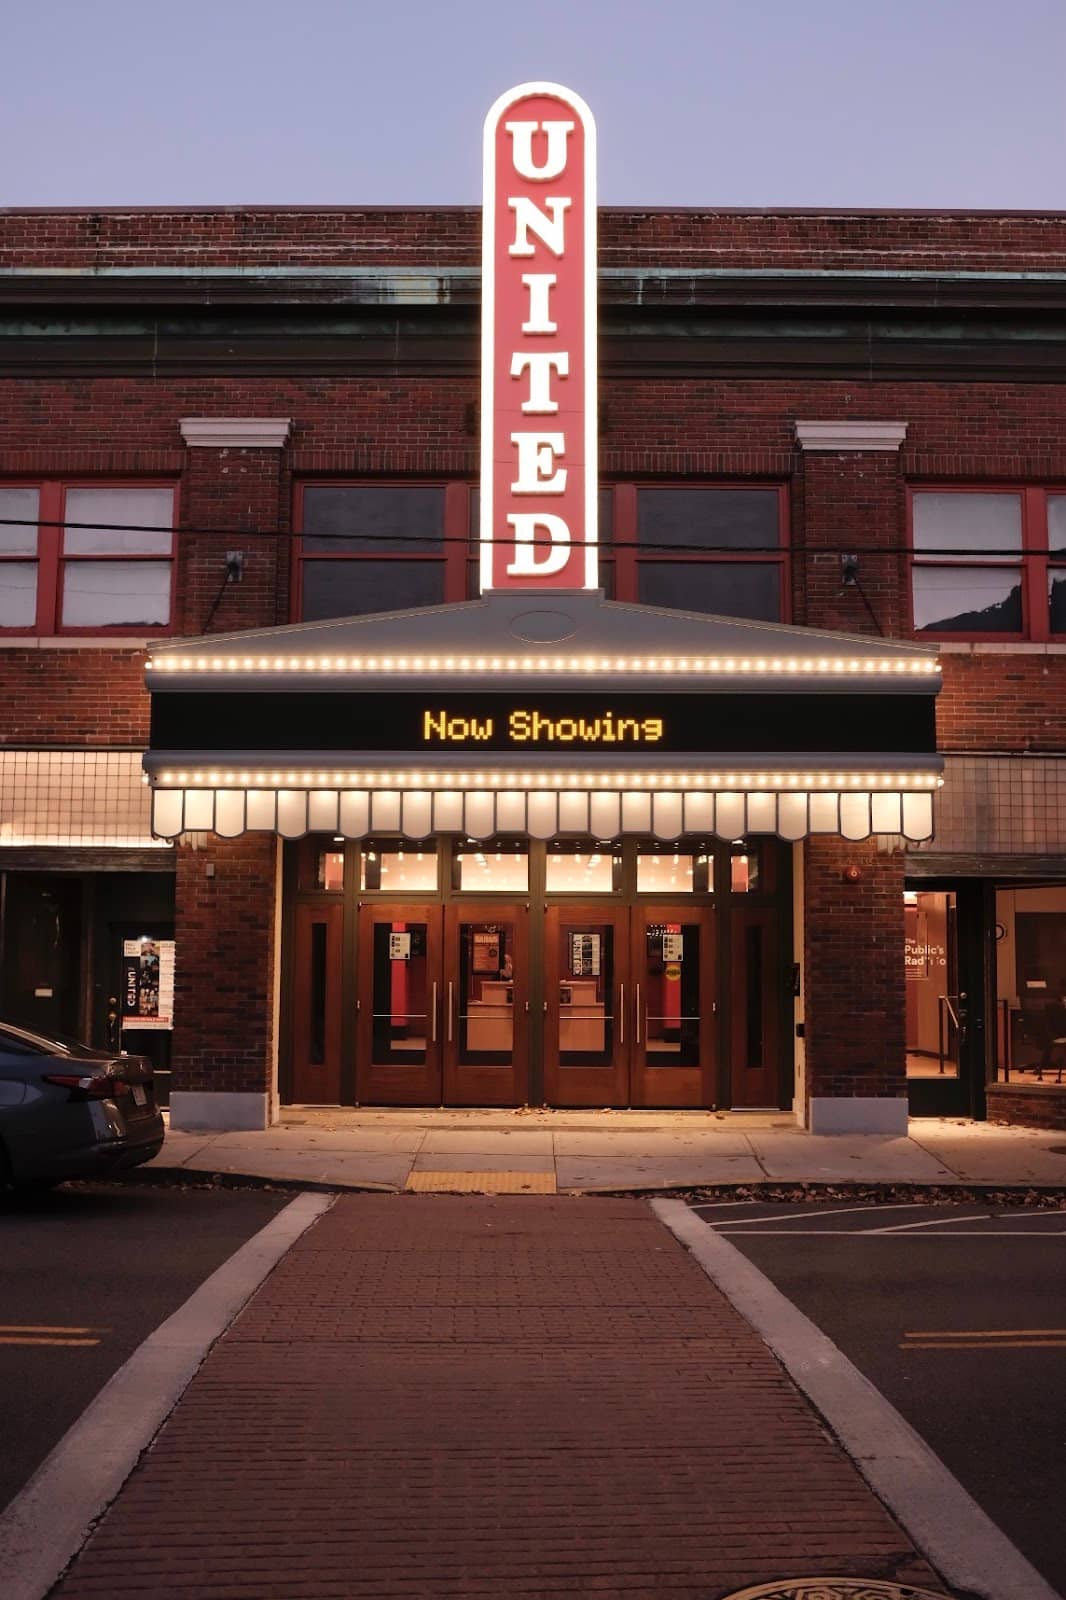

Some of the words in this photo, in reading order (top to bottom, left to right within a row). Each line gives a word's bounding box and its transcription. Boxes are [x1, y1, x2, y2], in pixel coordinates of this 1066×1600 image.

[505, 120, 575, 577] UNITED
[424, 711, 493, 740] Now
[509, 711, 663, 741] Showing
[904, 944, 945, 955] Public's
